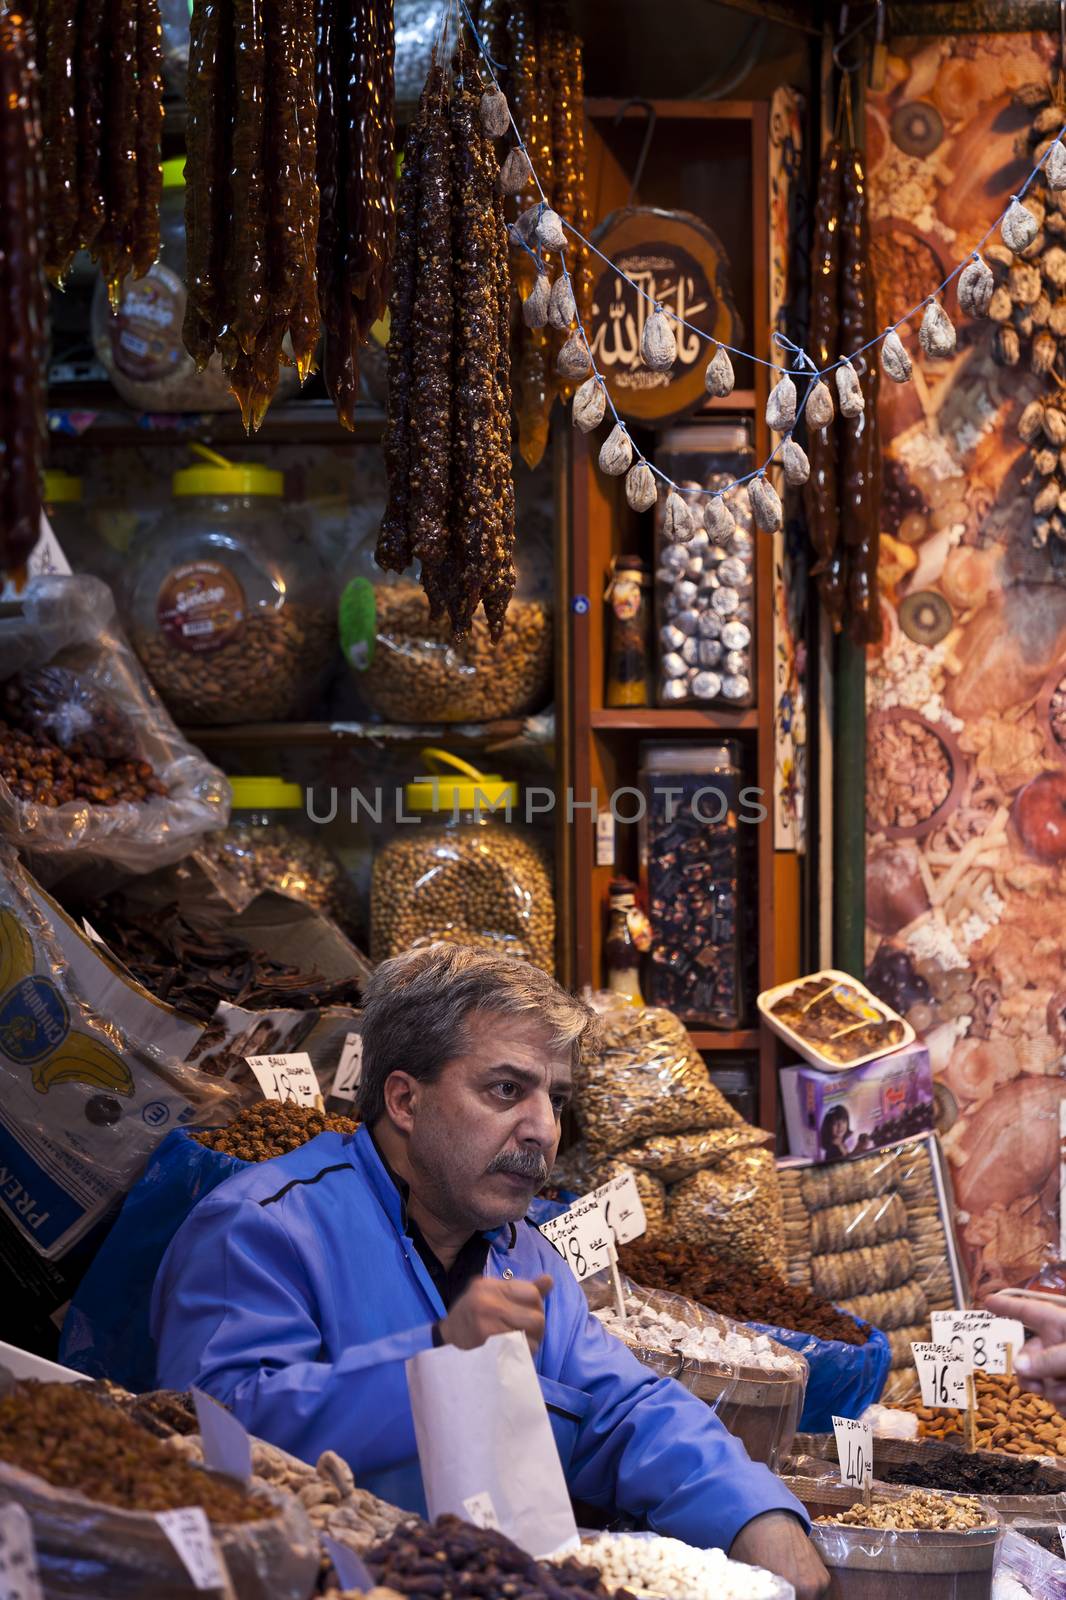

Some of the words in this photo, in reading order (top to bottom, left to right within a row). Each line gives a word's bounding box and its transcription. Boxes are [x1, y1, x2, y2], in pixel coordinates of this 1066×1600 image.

[22, 979, 65, 1044] Chiquita
[932, 1364, 949, 1405] 16
[846, 1440, 863, 1487] 40
